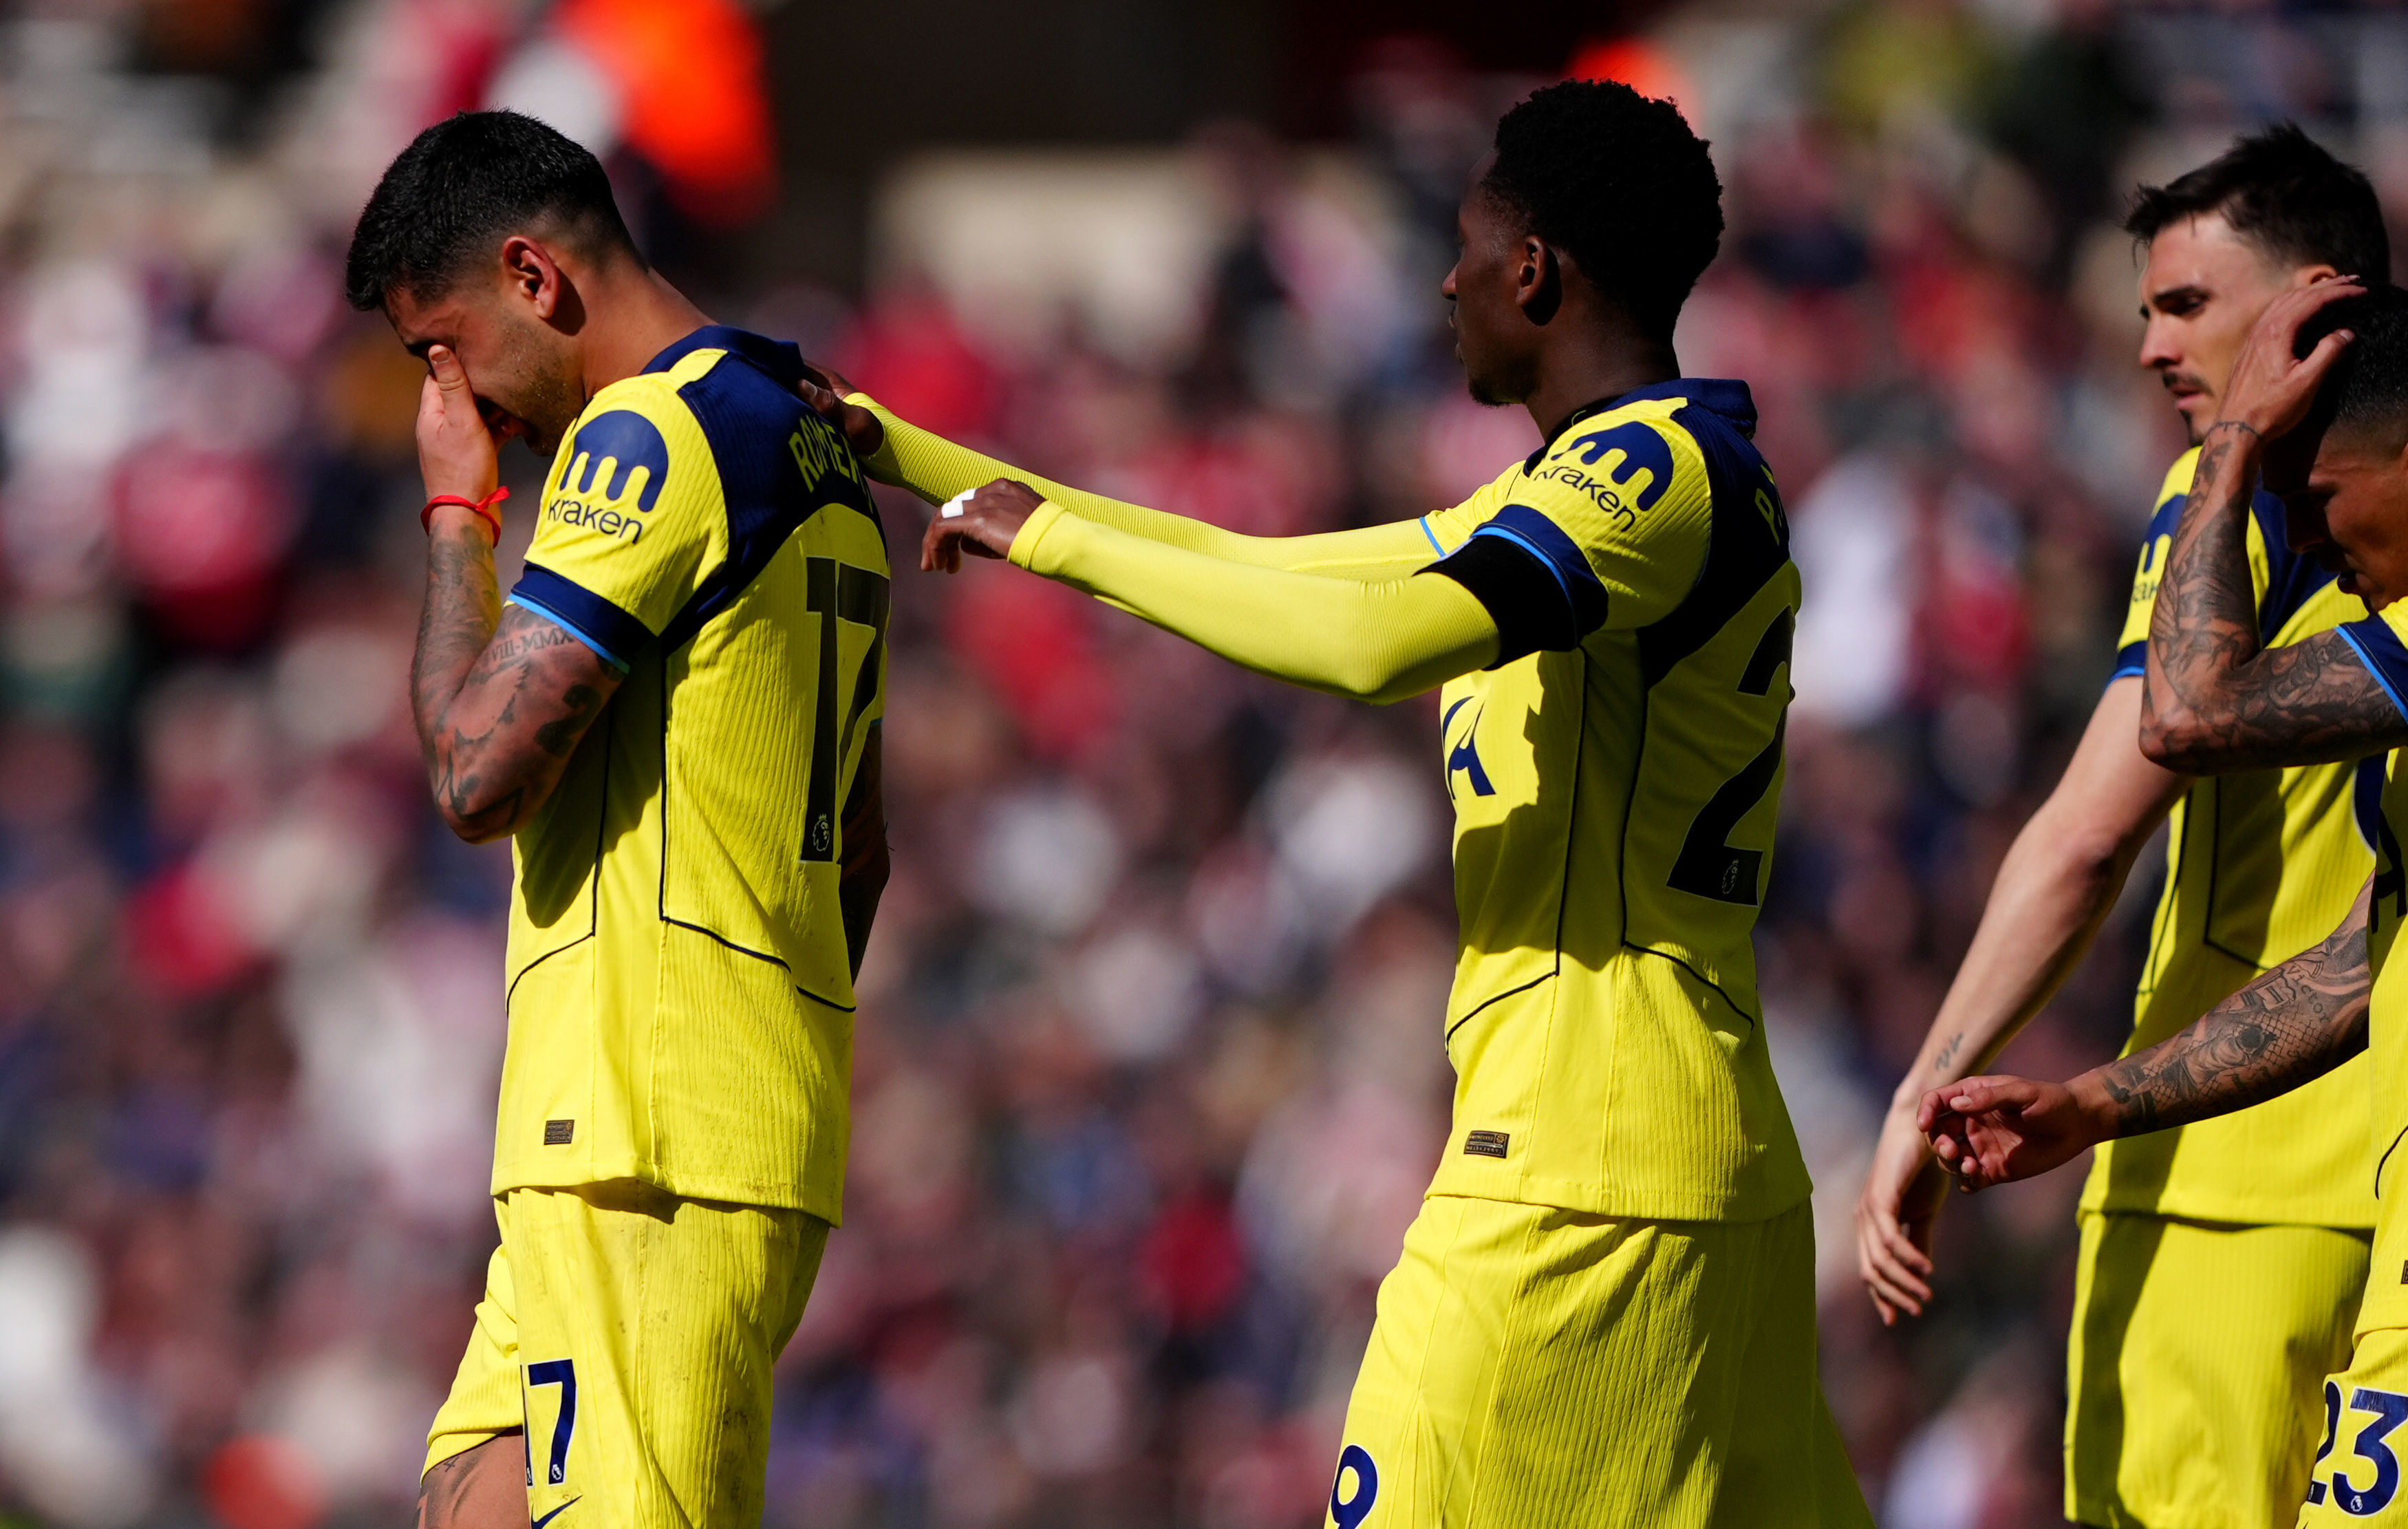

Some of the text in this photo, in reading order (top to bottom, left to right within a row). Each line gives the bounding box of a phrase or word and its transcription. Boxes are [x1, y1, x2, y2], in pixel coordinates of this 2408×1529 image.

[548, 499, 643, 544] kraken
[800, 556, 890, 863] 17
[519, 1358, 577, 1487] 7
